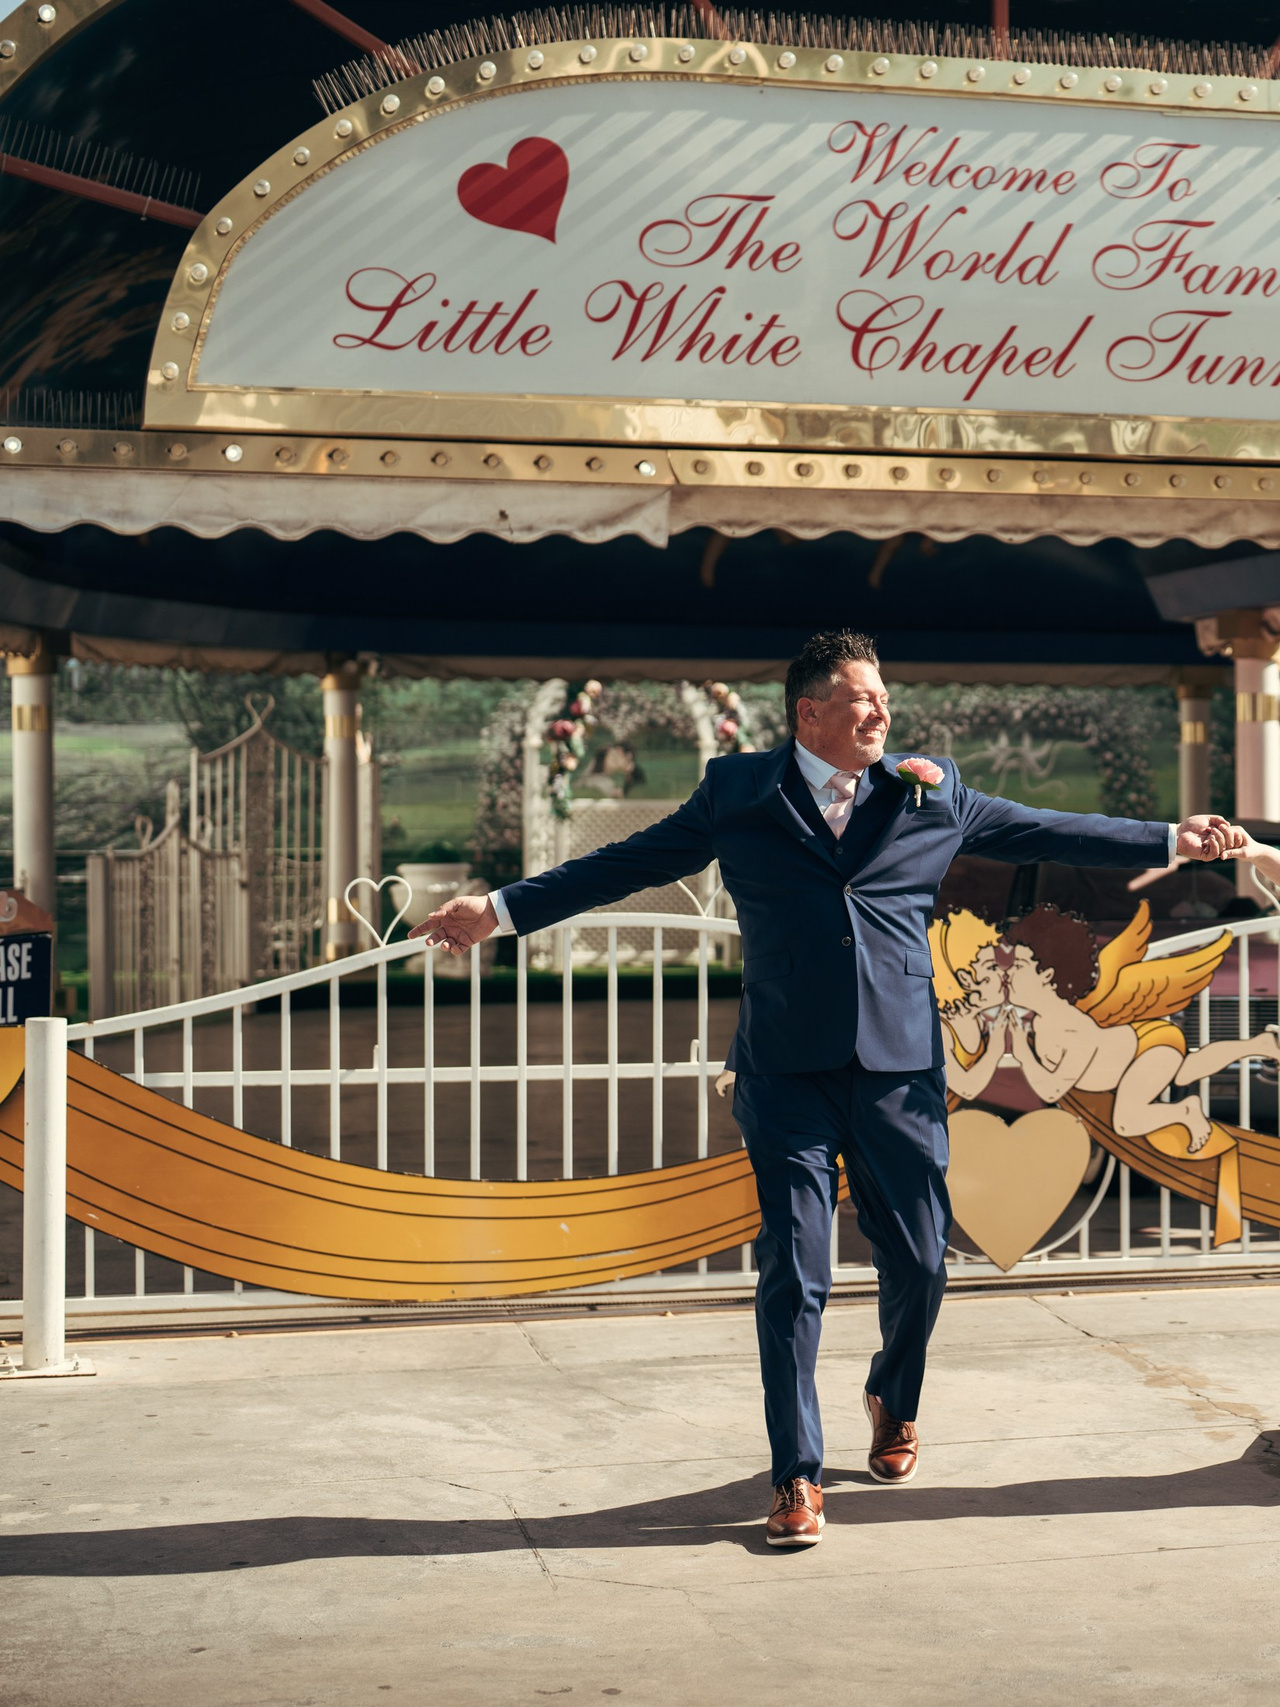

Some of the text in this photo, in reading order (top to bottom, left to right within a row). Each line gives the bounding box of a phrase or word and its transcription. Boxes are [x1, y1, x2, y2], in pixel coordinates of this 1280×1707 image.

[828, 119, 1201, 202] Welcome To
[638, 192, 801, 273] The
[832, 198, 1075, 285] World
[332, 266, 553, 357] Little
[584, 278, 802, 367] White
[835, 288, 1095, 402] Chapel
